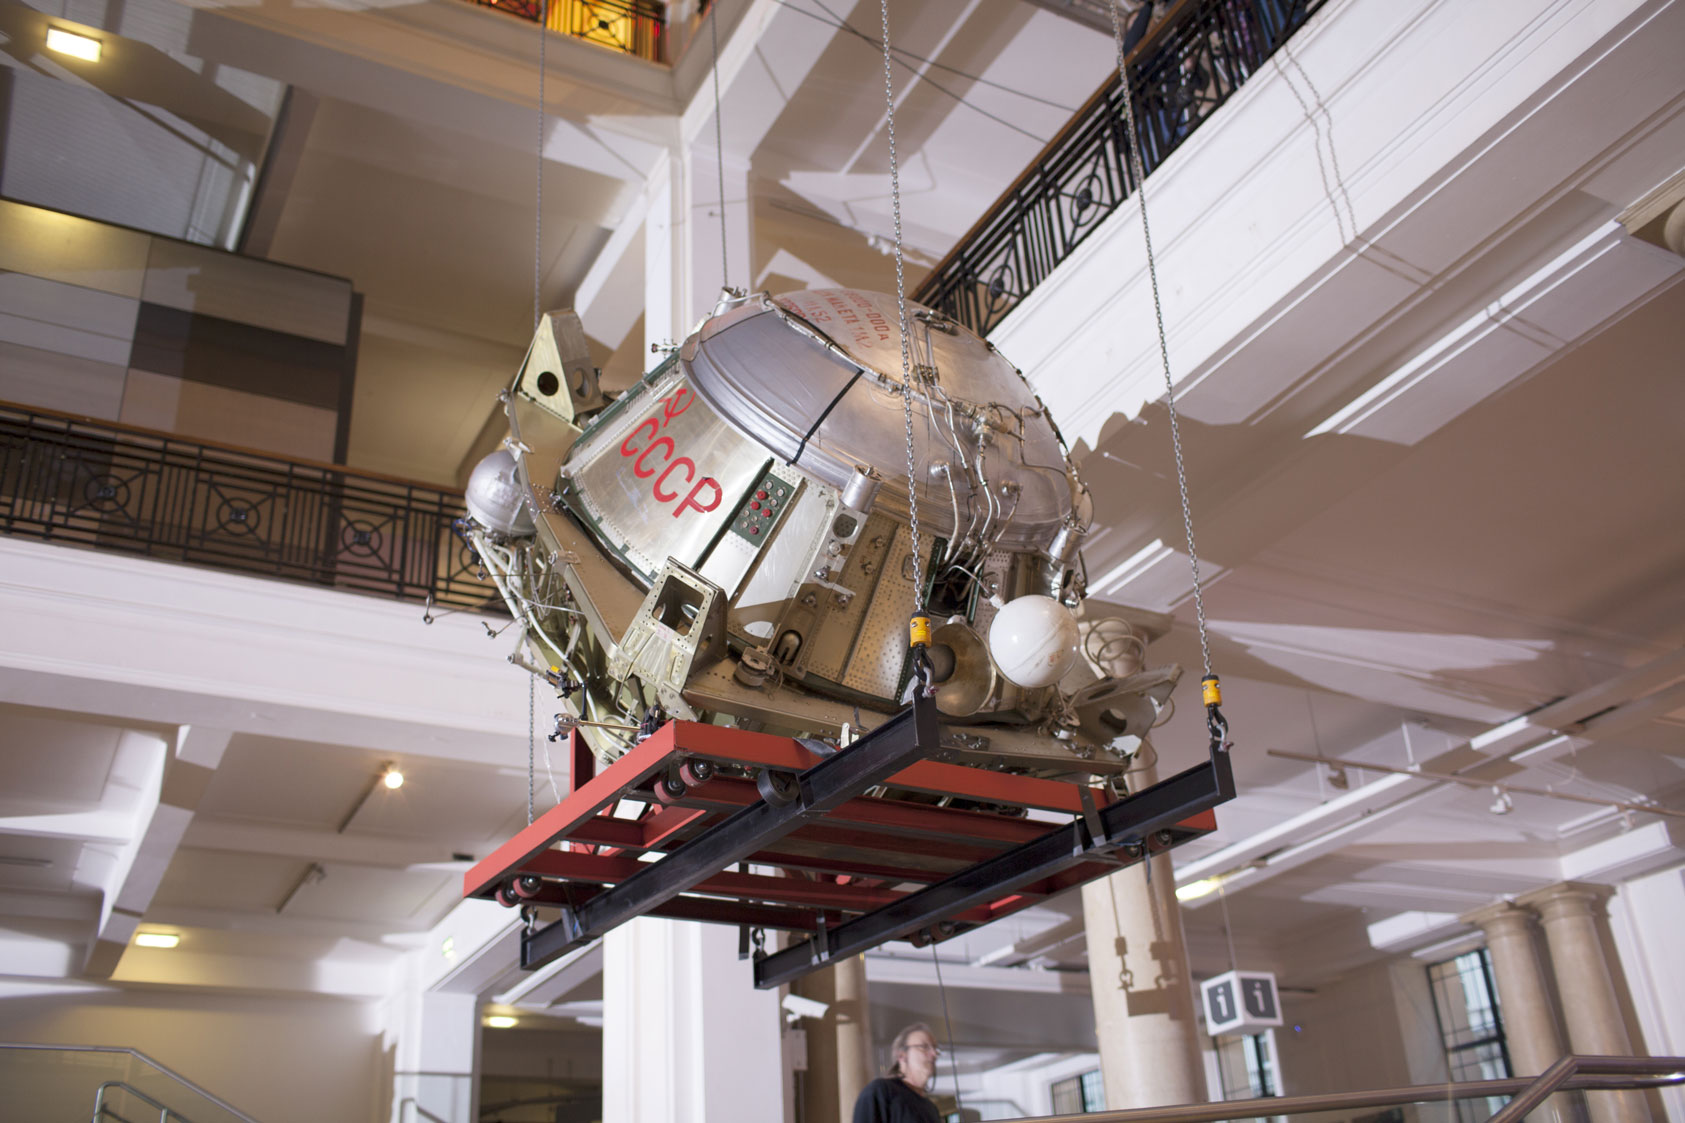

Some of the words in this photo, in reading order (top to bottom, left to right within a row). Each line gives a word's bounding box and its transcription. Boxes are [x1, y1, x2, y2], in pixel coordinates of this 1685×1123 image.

[620, 417, 723, 519] СССР
[1216, 987, 1228, 1017] i
[1253, 983, 1265, 1012] i
